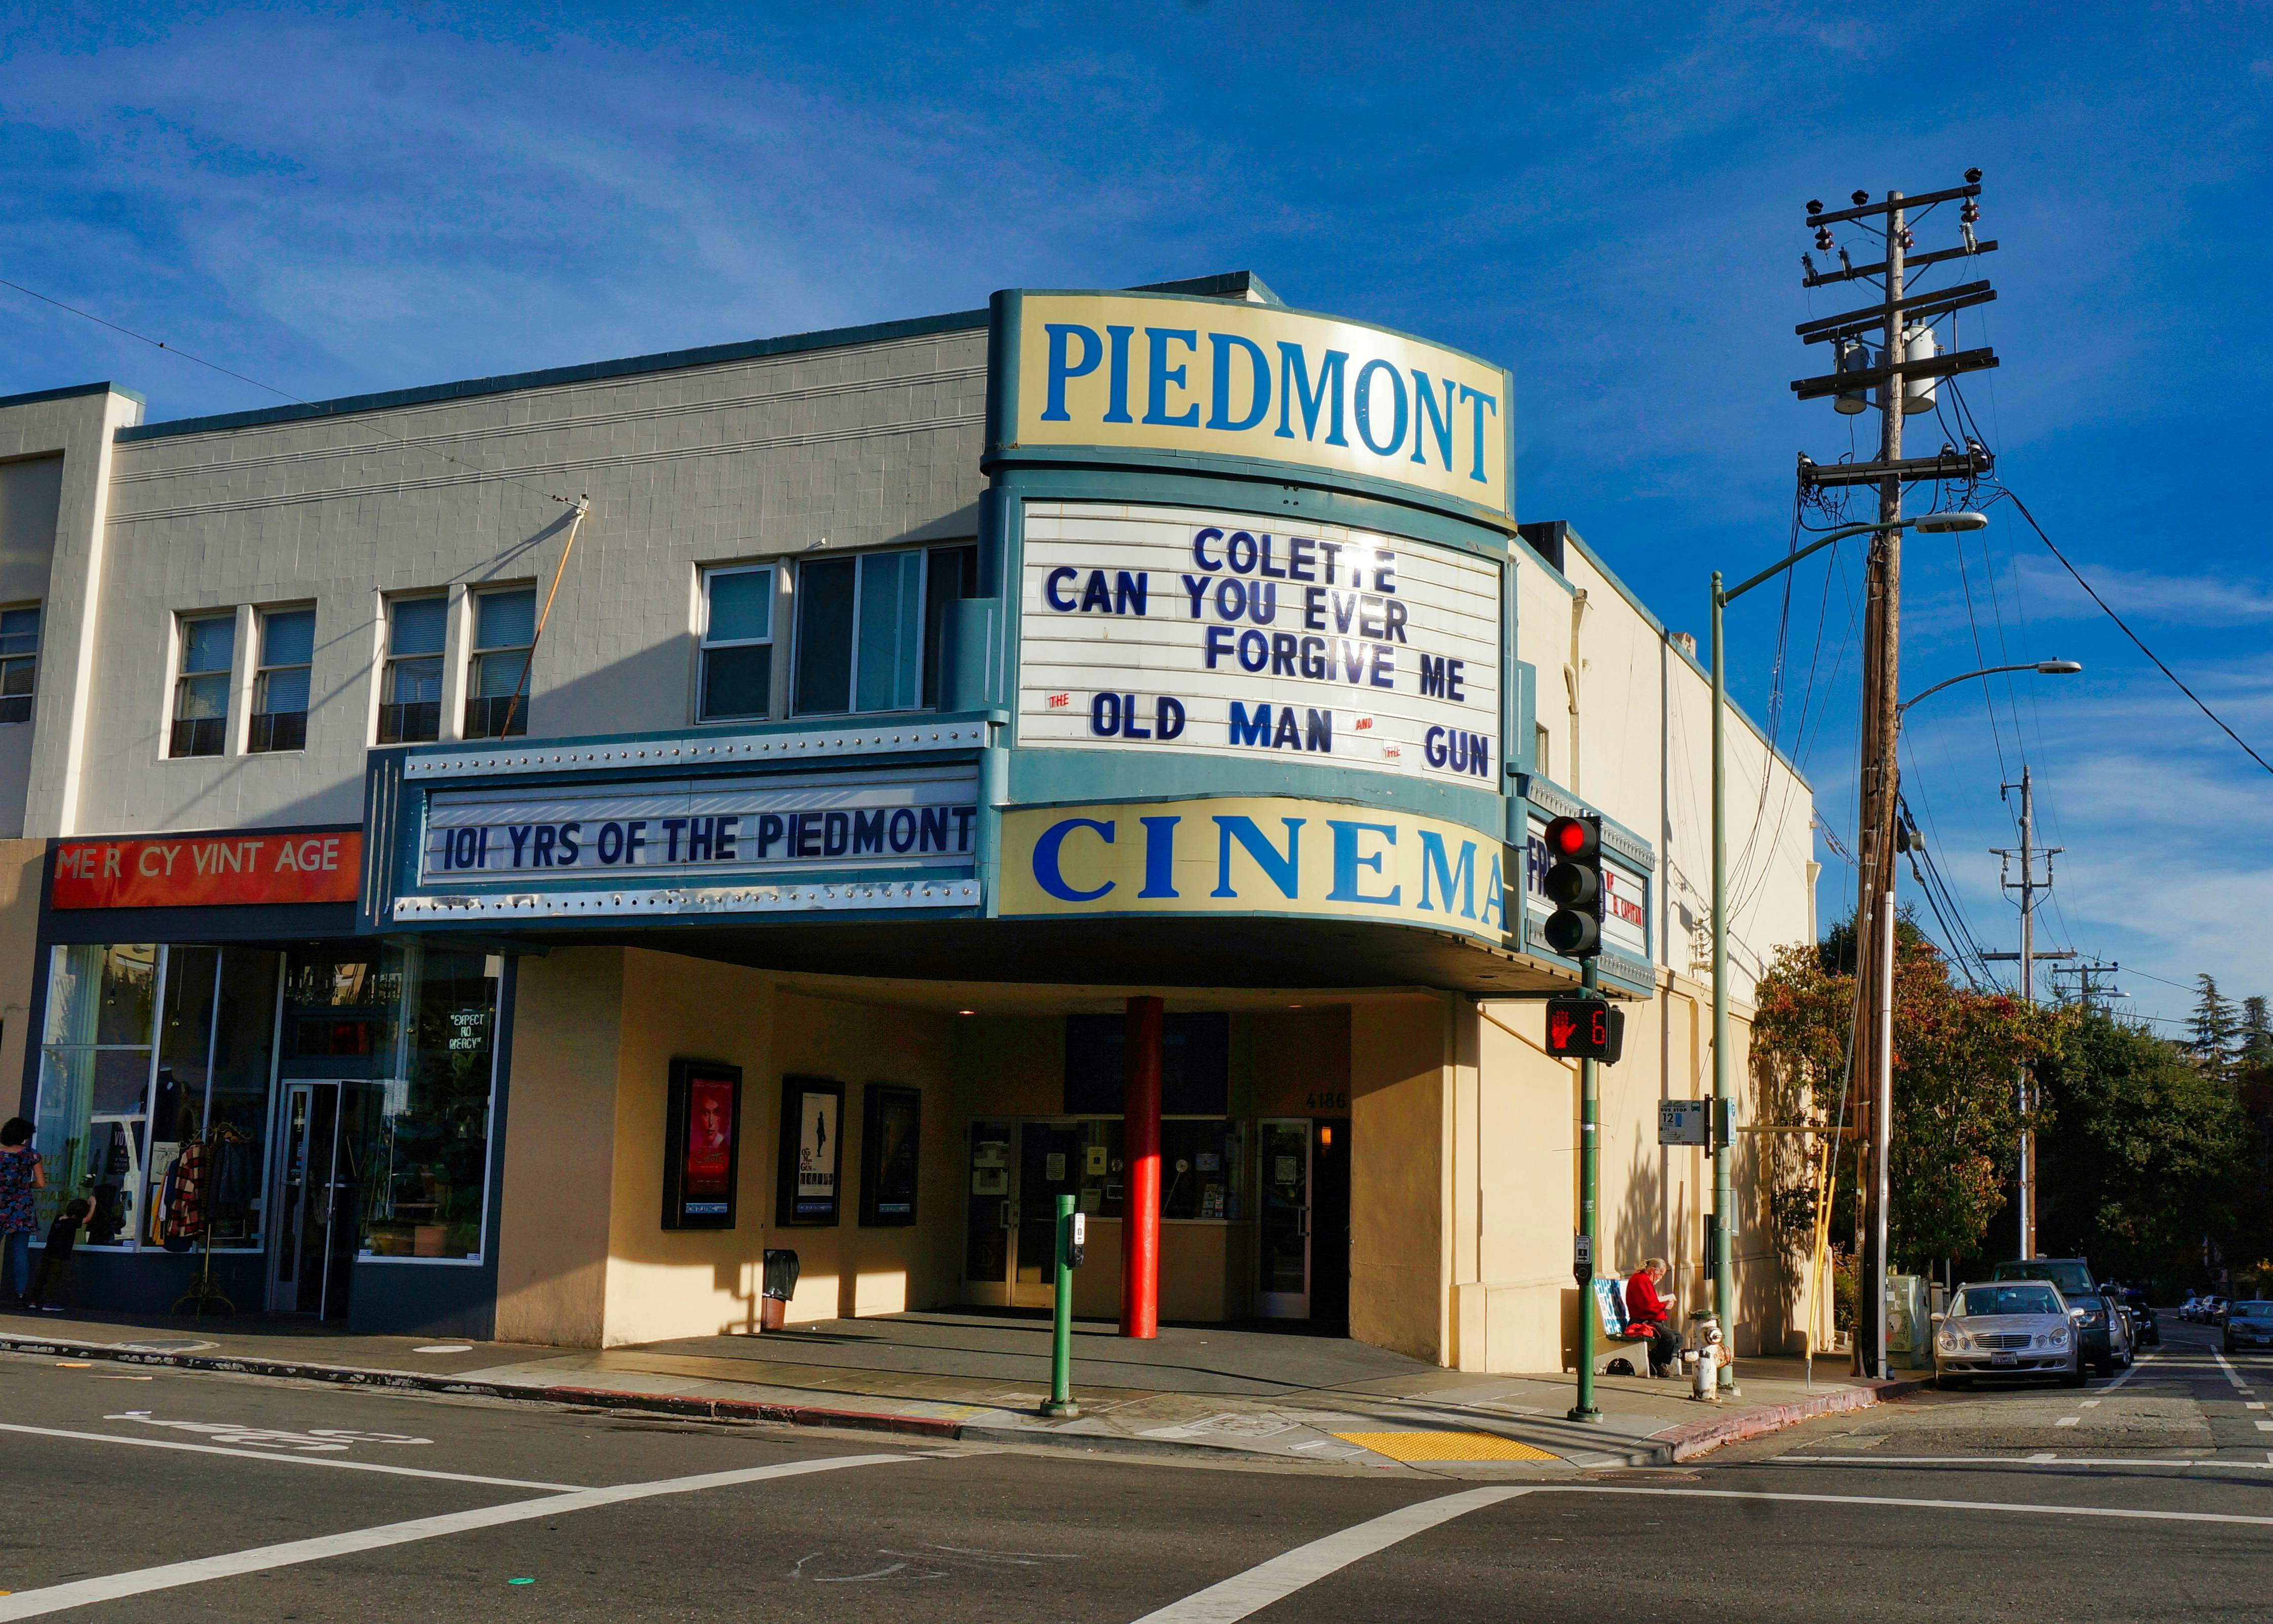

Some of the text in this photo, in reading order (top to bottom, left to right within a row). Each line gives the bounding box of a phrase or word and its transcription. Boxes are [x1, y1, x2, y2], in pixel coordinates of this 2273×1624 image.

[1041, 323, 1496, 485] PIEDMONT
[1193, 527, 1397, 594] COLETTE
[1047, 567, 1408, 643] CAN YOU EVER
[1205, 626, 1465, 702] FORGIVE ME
[1049, 691, 1488, 778] THE OLD MAN AND THE GUN
[443, 805, 978, 870] 101 YRS OF THE PIEDMONT
[1032, 814, 1510, 932] CINEMA
[460, 1026, 472, 1037] NO
[1306, 1092, 1346, 1108] 4186
[1663, 1113, 1673, 1123] 12
